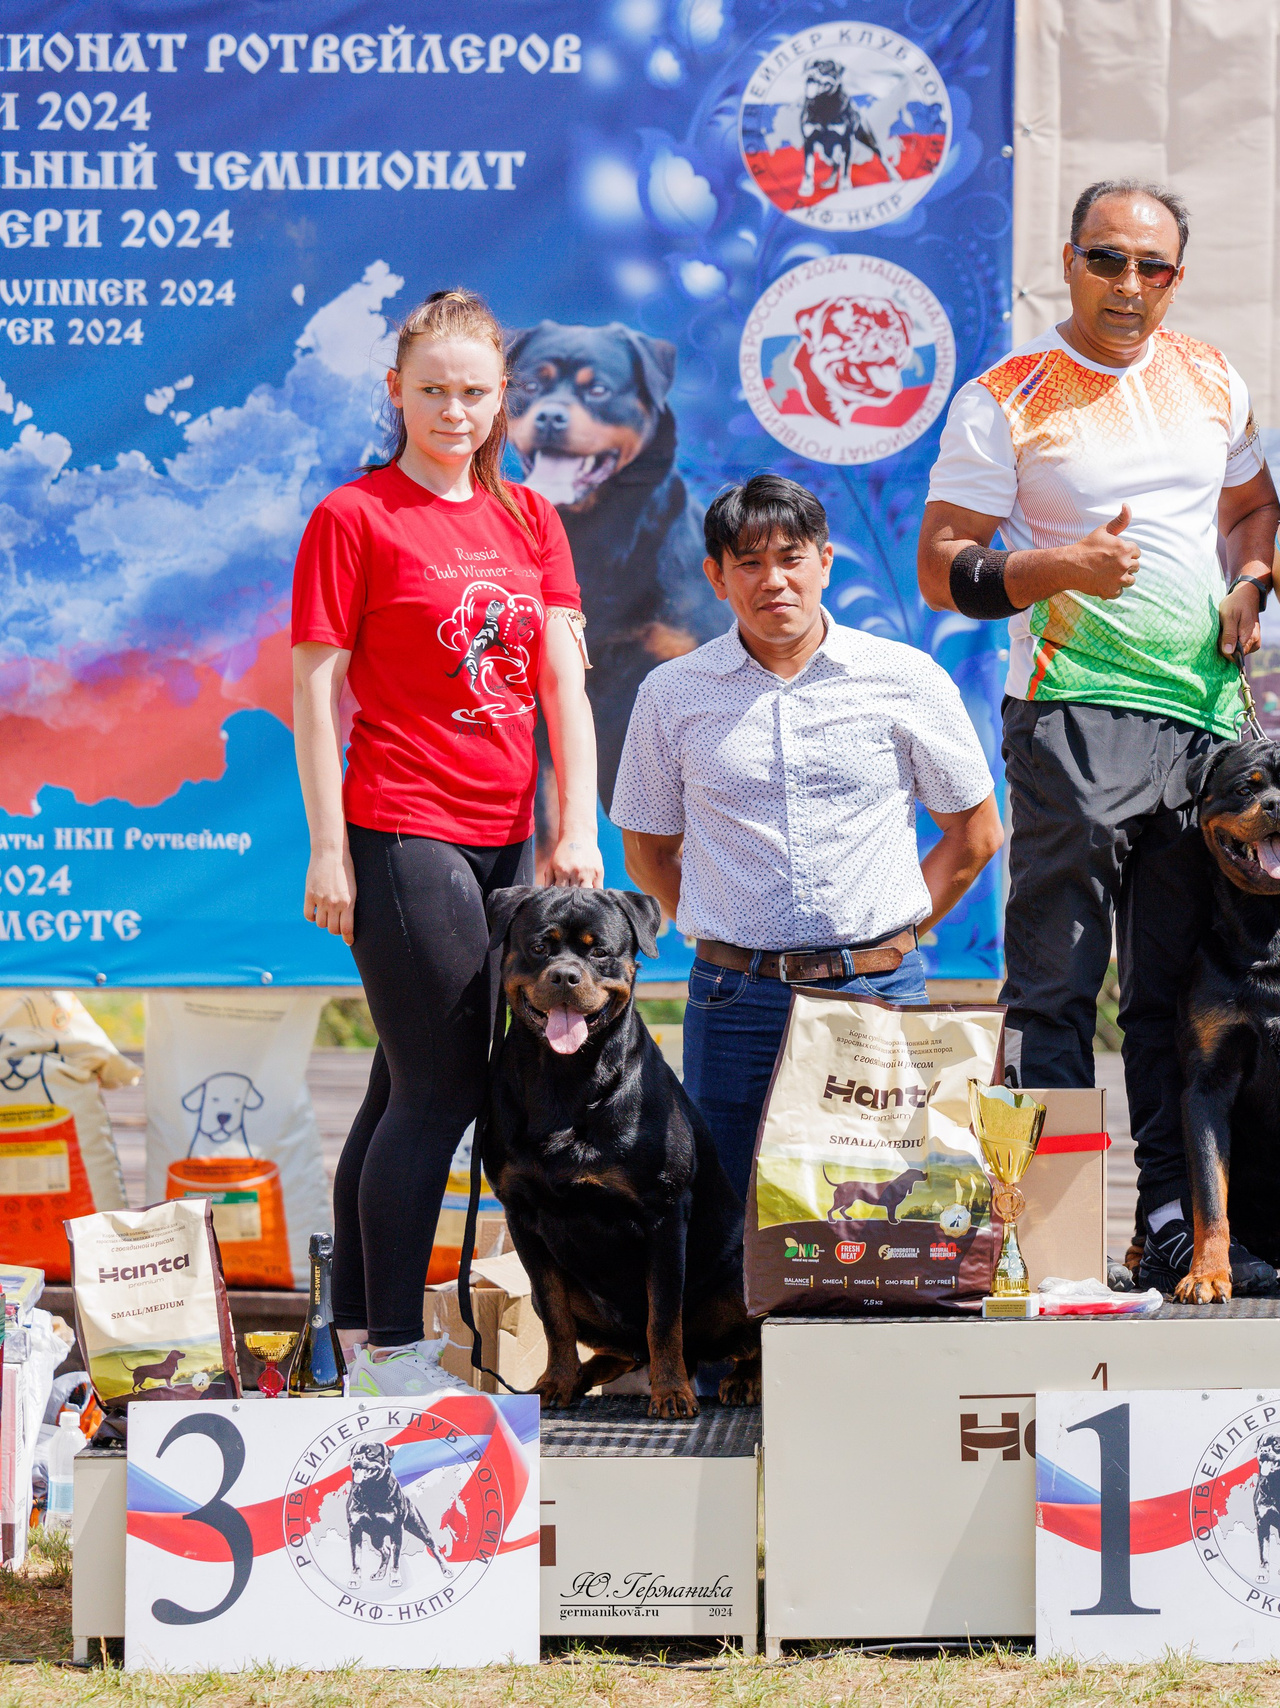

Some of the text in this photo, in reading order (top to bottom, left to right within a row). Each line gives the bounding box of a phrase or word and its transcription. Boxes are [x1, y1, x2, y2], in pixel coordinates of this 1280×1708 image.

[0, 24, 582, 74] ИОНАТ РОТВЕЙЛЕРОВ
[839, 29, 909, 60] КЛУБ
[37, 91, 151, 131] 2024
[1, 141, 526, 191] ЬНЫЙ ЧЕМПИОНАТ
[0, 208, 235, 249] ЕРИ 2024
[801, 256, 849, 281] 2024
[0, 278, 236, 307] WINNER 2024
[0, 317, 145, 346] ER 2024
[454, 546, 499, 561] Russia
[423, 563, 458, 581] Club
[54, 827, 115, 850] НКП
[124, 827, 252, 856] Ротвейлер
[836, 1036, 869, 1049] взрослых
[848, 1029, 867, 1039] Корм
[860, 1112, 911, 1122] premium
[799, 1243, 820, 1259] NWC
[840, 1244, 861, 1252] FRESH
[840, 1252, 857, 1260] MEAT
[98, 1253, 190, 1284] Hanta
[128, 1277, 165, 1289] premium
[111, 1300, 185, 1320] SMALL/MEDIUM
[286, 1411, 501, 1569] РОТВЕЙЛЕР КЛУБ РОССИИ
[1194, 1407, 1276, 1561] РОТВЕЙЛЕР
[151, 1412, 254, 1625] 3
[1066, 1402, 1161, 1616] 1
[338, 1587, 456, 1621] РКФ-НКПР
